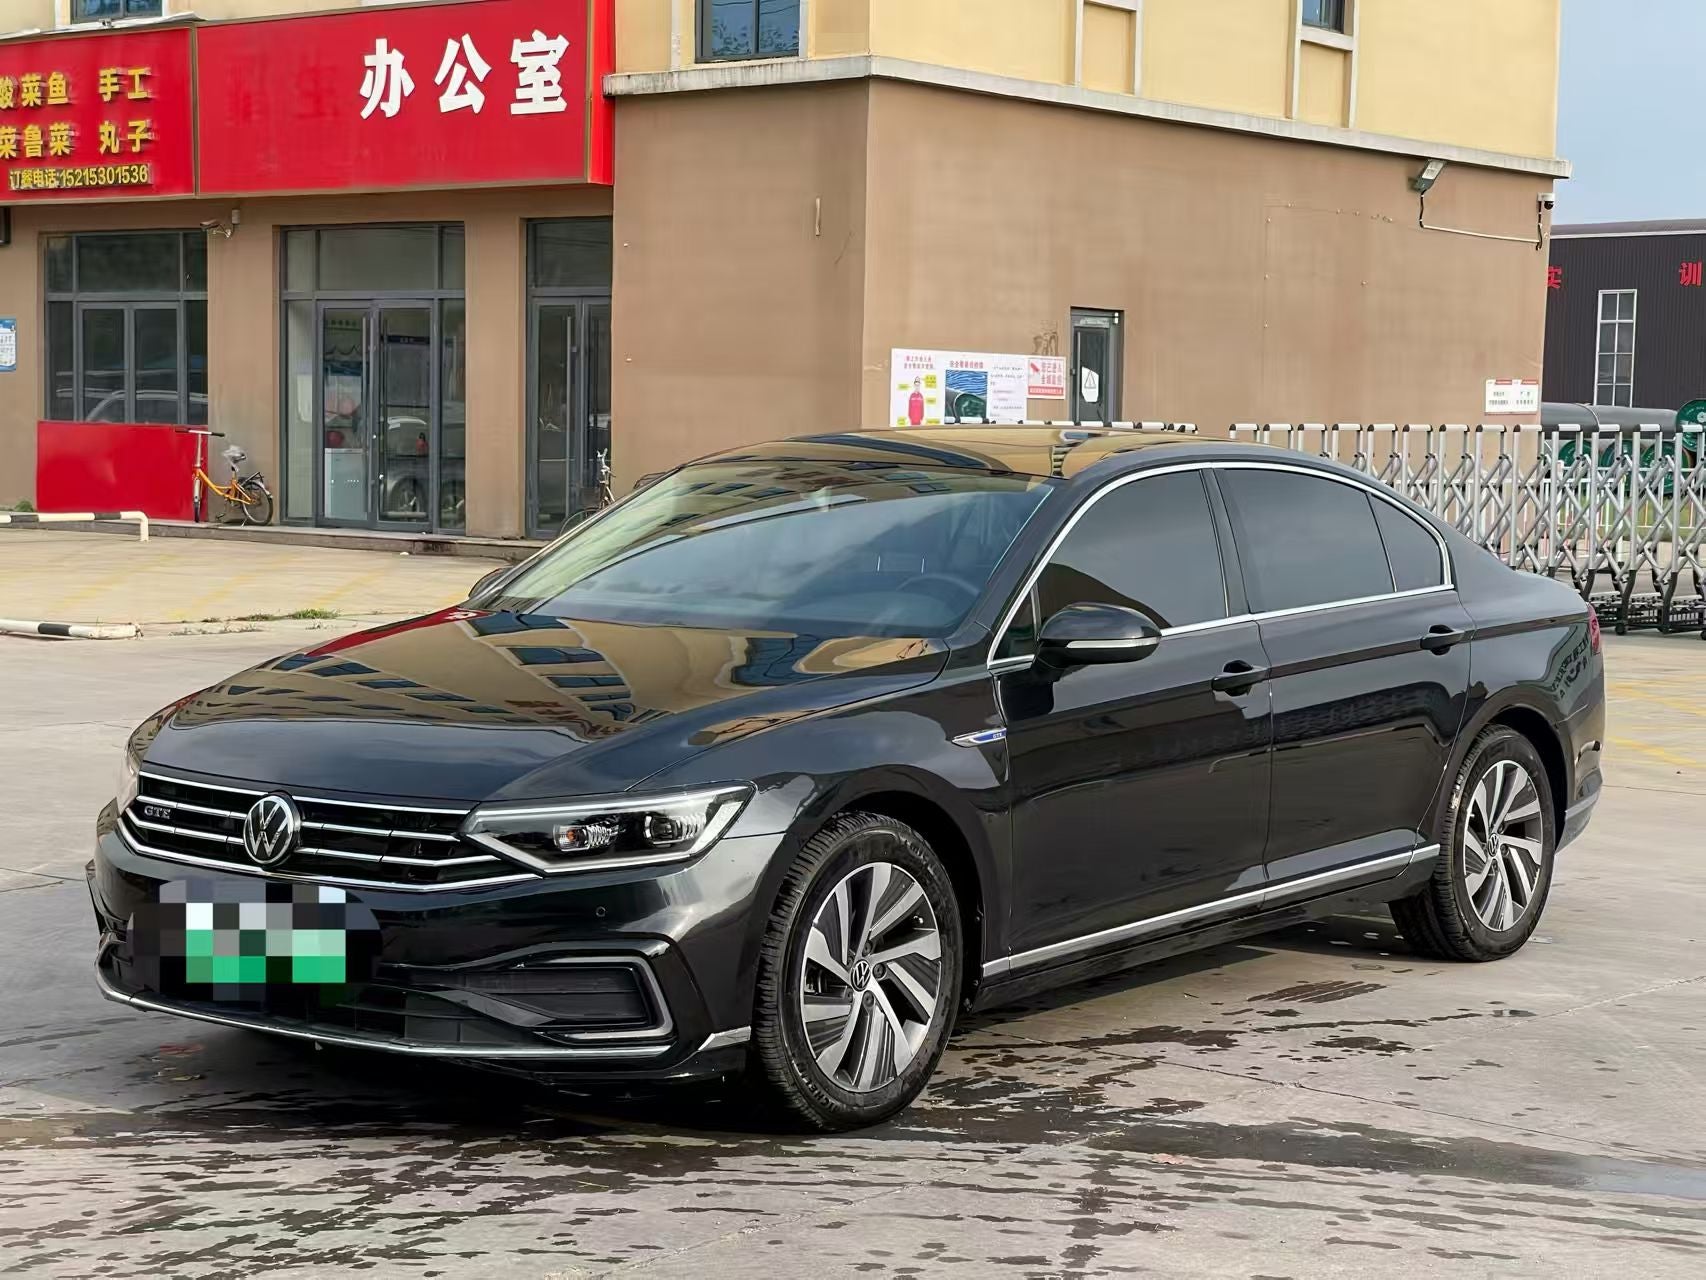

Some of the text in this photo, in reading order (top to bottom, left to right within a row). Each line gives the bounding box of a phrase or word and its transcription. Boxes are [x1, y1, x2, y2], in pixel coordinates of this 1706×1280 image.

[99, 67, 149, 102] 手工
[359, 29, 570, 119] 办公室
[100, 120, 150, 154] 丸子
